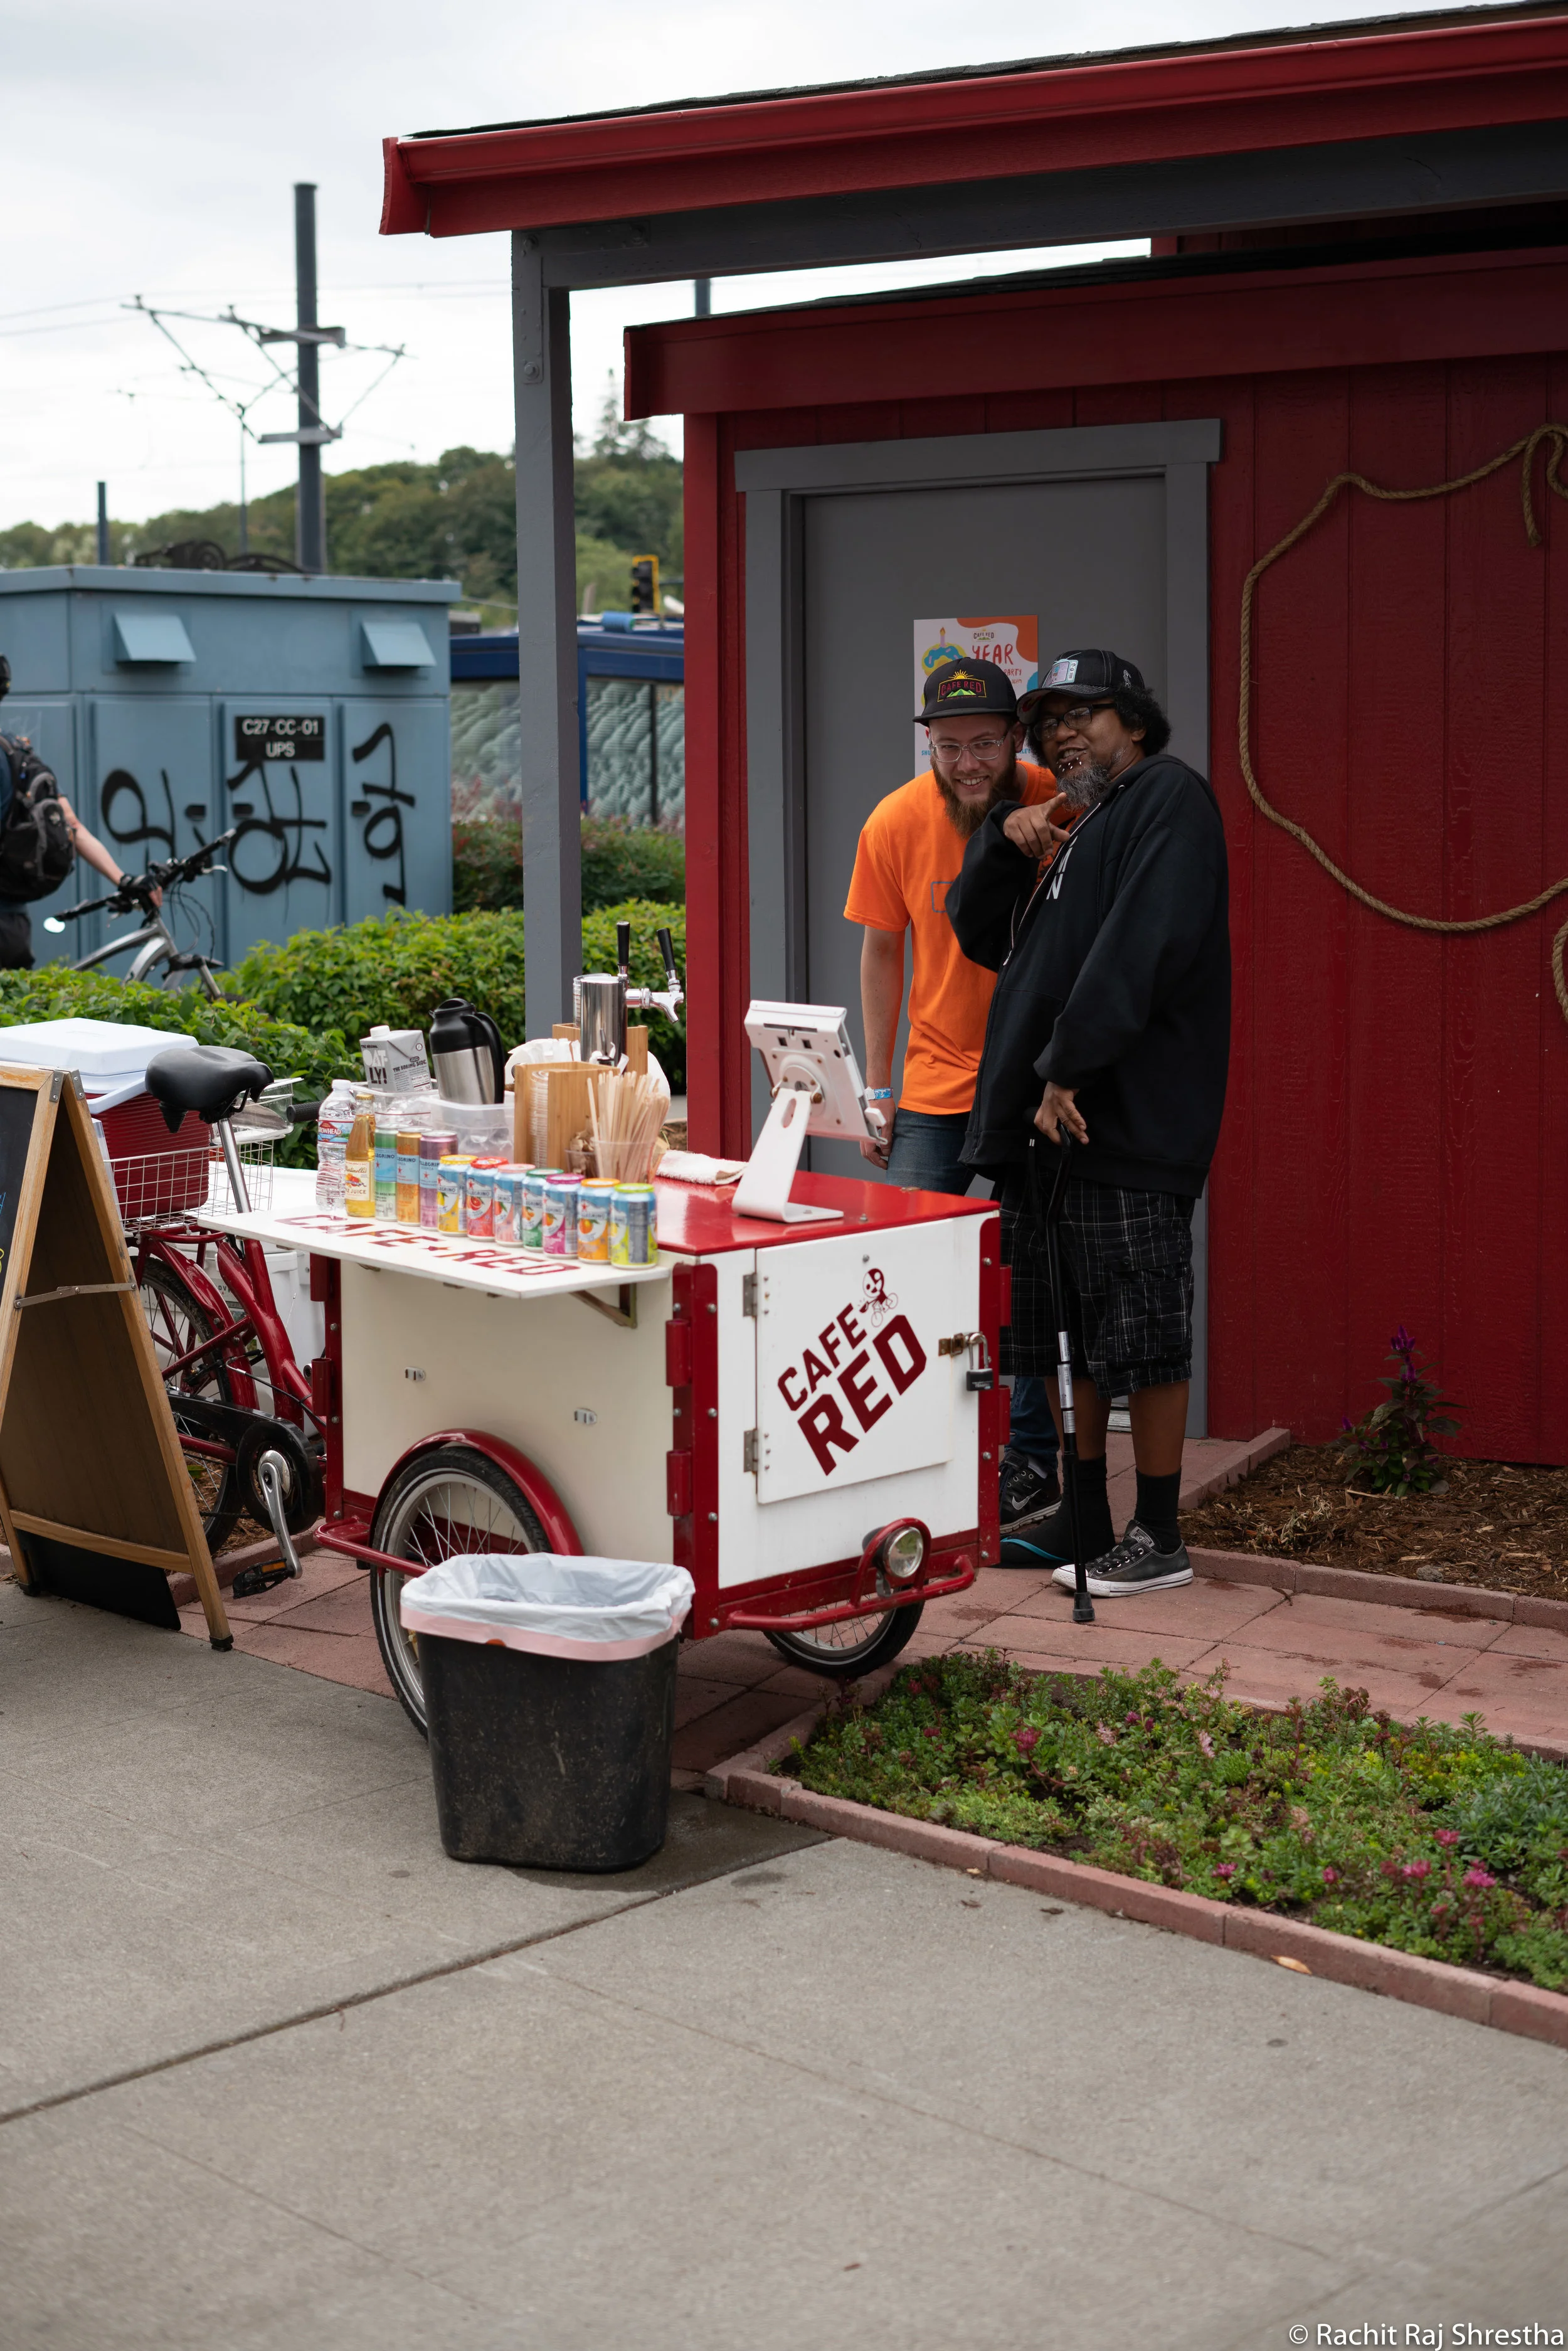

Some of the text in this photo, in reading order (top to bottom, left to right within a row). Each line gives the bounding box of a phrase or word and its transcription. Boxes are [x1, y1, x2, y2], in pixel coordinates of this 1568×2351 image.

[972, 644, 1014, 665] YEAR
[941, 681, 982, 696] CAFE RED
[242, 718, 319, 735] C27-CC-01
[265, 741, 295, 758] UPS
[369, 1067, 387, 1084] LY!
[275, 1214, 581, 1275] CAFE RED
[778, 1303, 867, 1411] CAFE
[797, 1315, 927, 1477] RED
